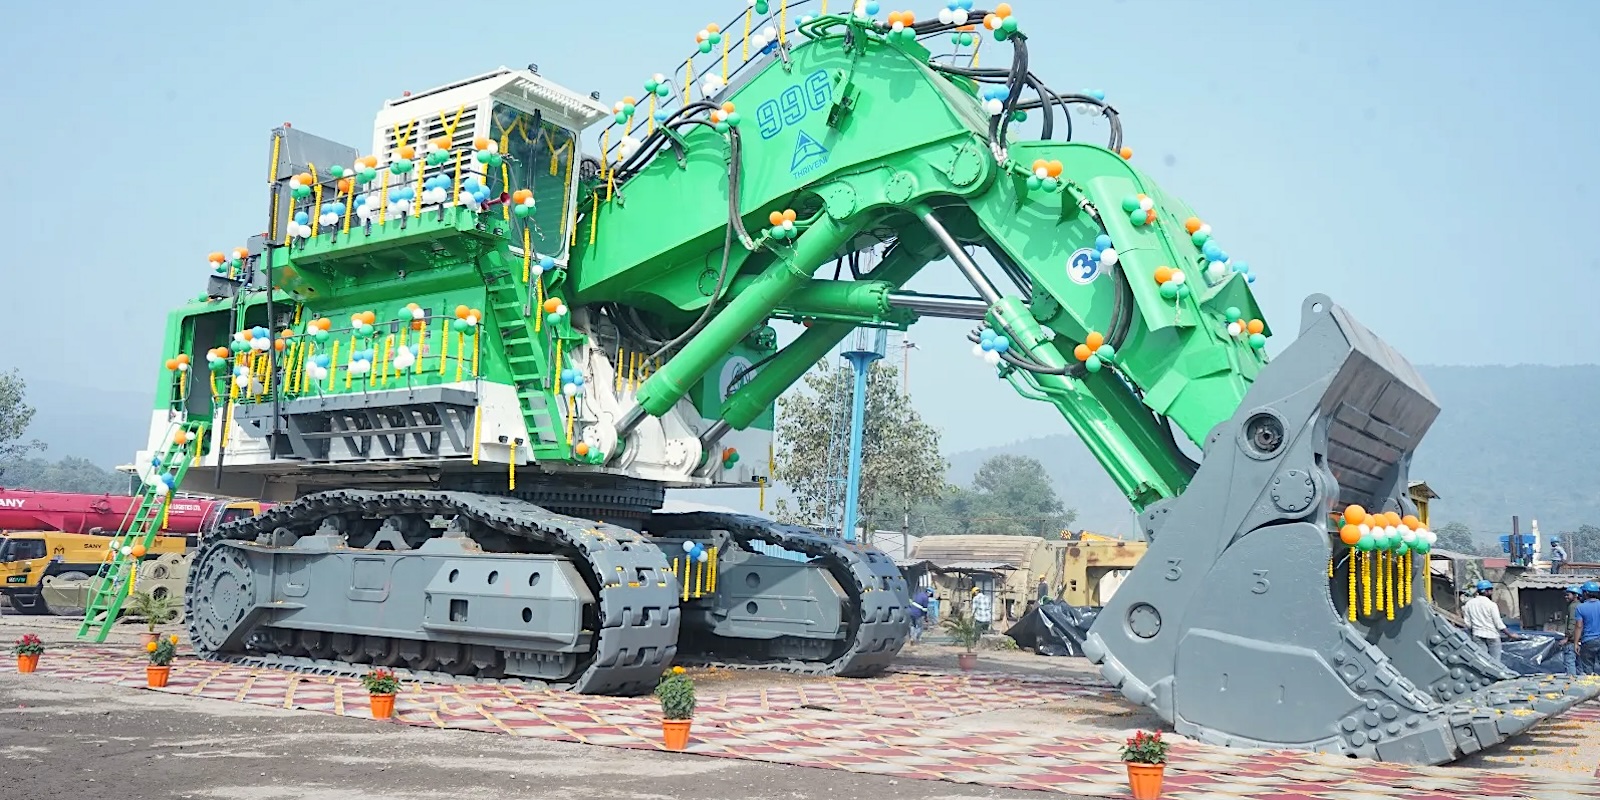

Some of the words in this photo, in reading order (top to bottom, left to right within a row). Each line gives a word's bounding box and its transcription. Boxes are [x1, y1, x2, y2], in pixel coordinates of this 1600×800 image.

[757, 69, 832, 139] 996
[1072, 253, 1097, 279] 3
[1165, 558, 1183, 581] 3
[1251, 569, 1271, 595] 3
